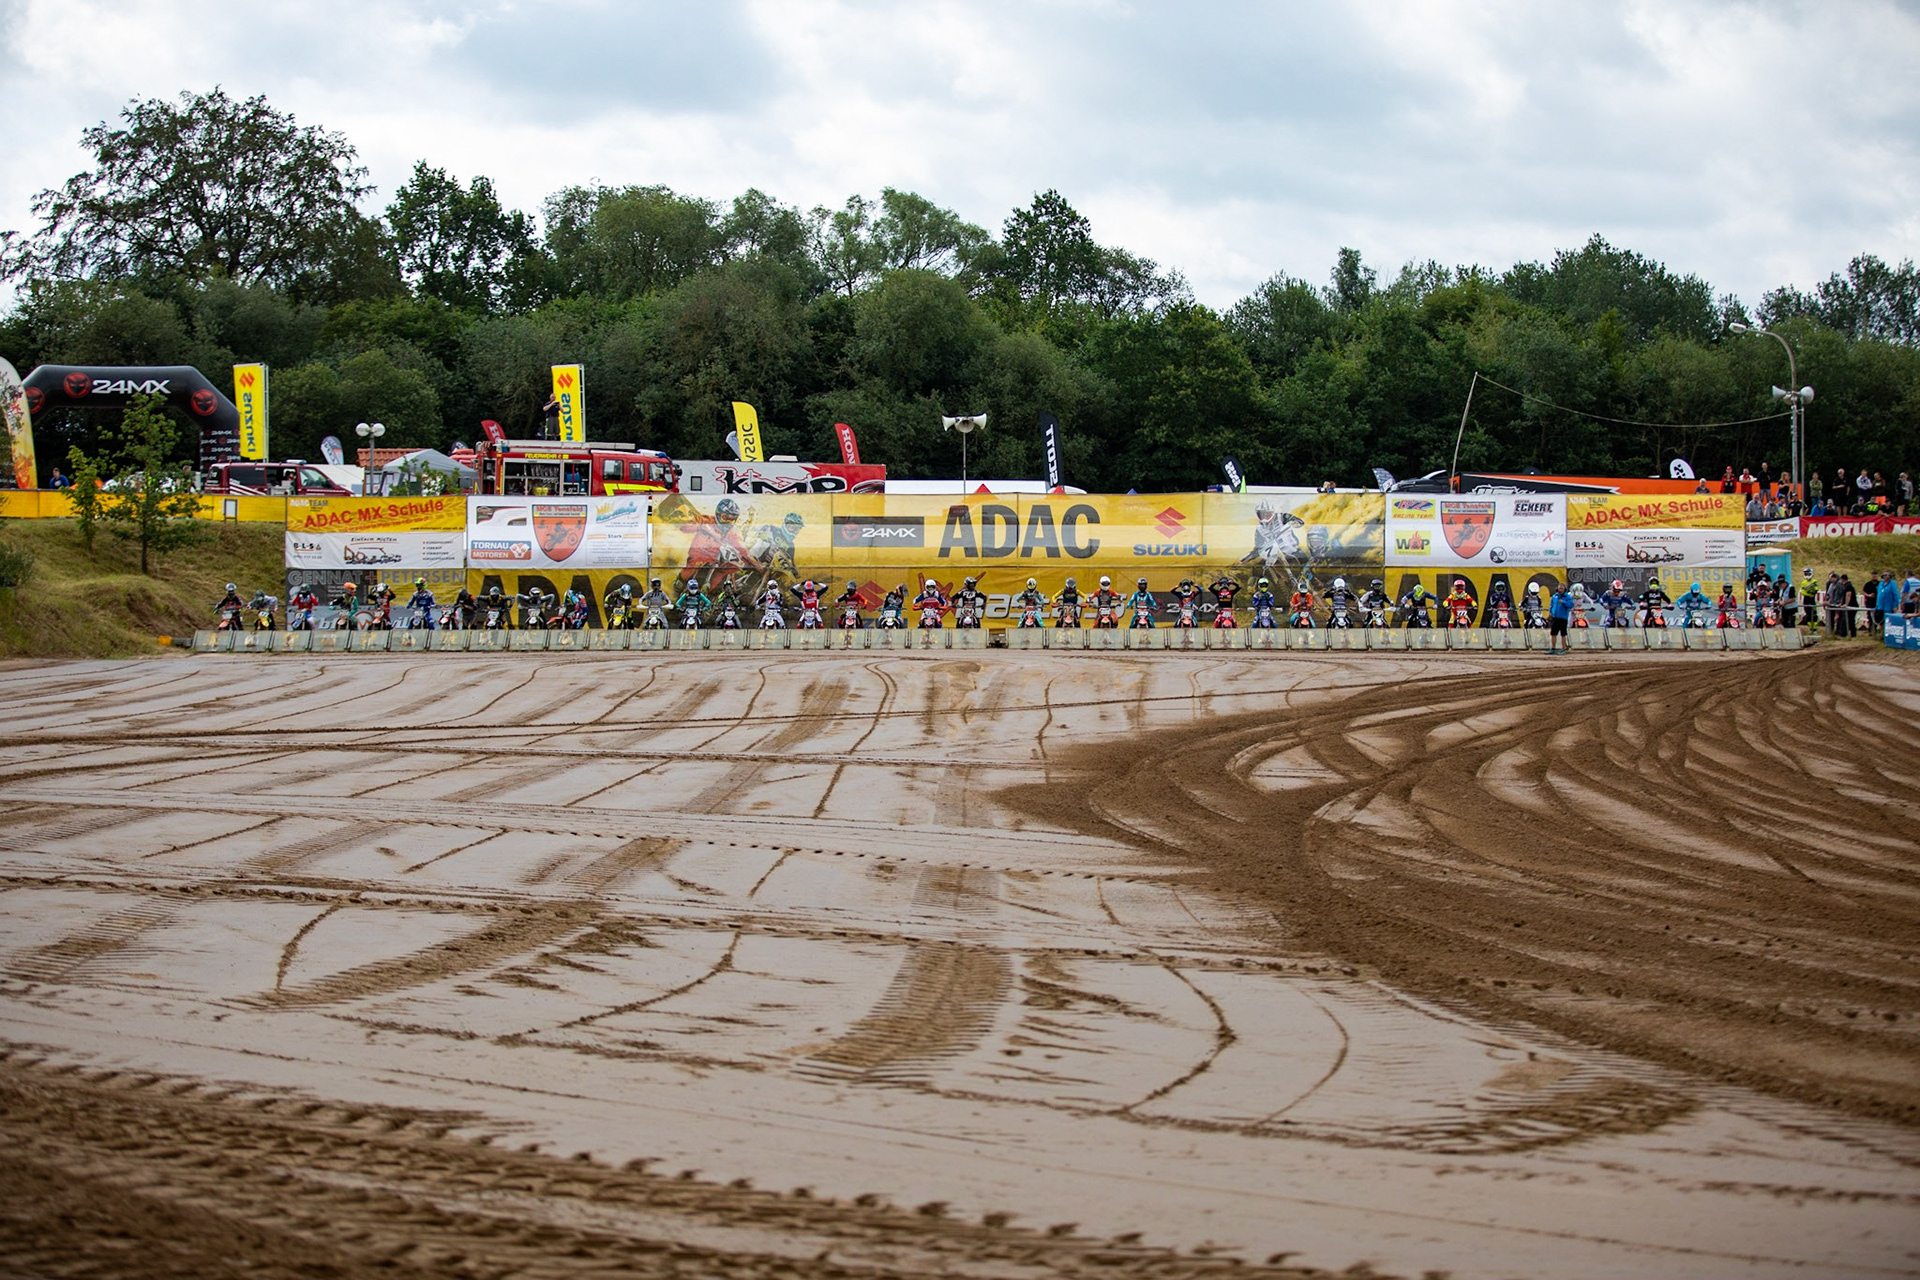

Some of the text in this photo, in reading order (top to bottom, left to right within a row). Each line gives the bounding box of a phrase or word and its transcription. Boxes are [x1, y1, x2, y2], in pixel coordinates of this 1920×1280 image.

[92, 380, 172, 394] 24MX
[304, 510, 353, 528] ADAC
[357, 506, 383, 521] MX
[388, 500, 444, 517] Schule
[1584, 507, 1633, 526] ADAC
[1638, 502, 1664, 517] MX
[1668, 497, 1723, 514] Schule
[861, 528, 917, 538] 24MX
[938, 504, 1101, 559] ADAC
[1806, 523, 1878, 538] MOTUL
[1133, 544, 1207, 556] SUZUKI
[1509, 549, 1540, 557] druckguss
[288, 570, 363, 585] GENNAT
[381, 569, 465, 583] PETERSEN
[1568, 567, 1643, 582] GENNAT
[1662, 568, 1745, 582] PETERSEN
[472, 574, 646, 629] ADAC
